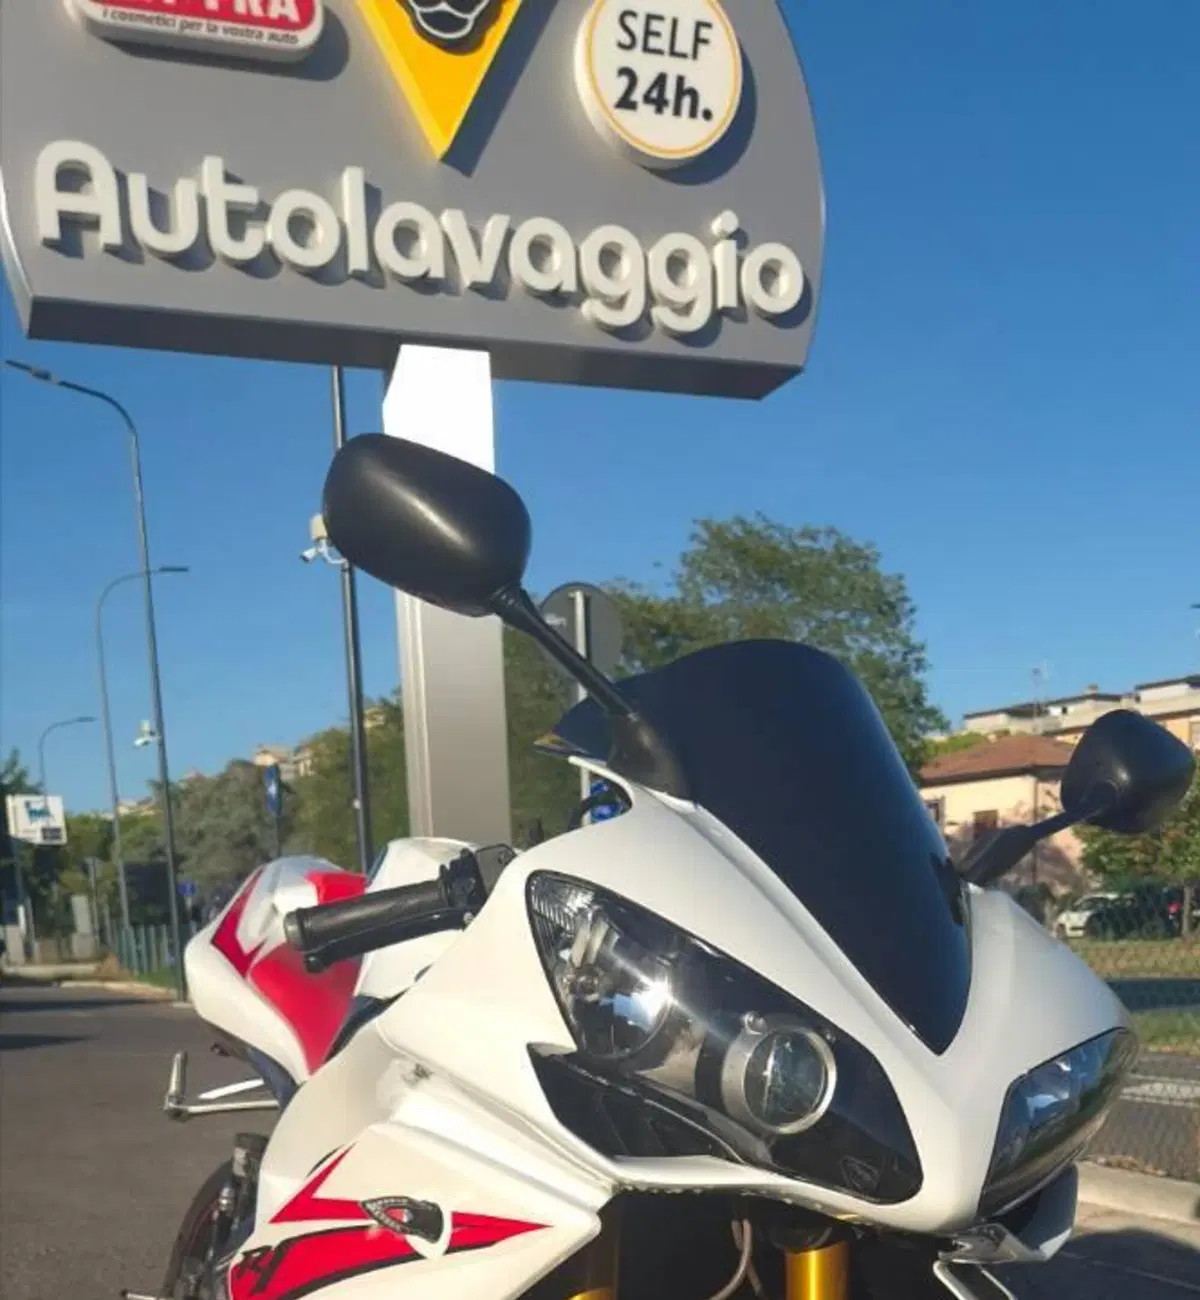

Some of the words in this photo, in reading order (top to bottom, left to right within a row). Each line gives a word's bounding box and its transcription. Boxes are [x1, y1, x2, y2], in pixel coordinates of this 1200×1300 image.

[109, 10, 176, 28] cosmetici
[180, 18, 201, 33] per
[206, 22, 218, 32] la
[222, 25, 264, 41] vostra
[267, 32, 299, 44] auto
[616, 9, 713, 61] SELF
[614, 66, 713, 121] 24h.
[35, 140, 804, 335] Autolavaggio
